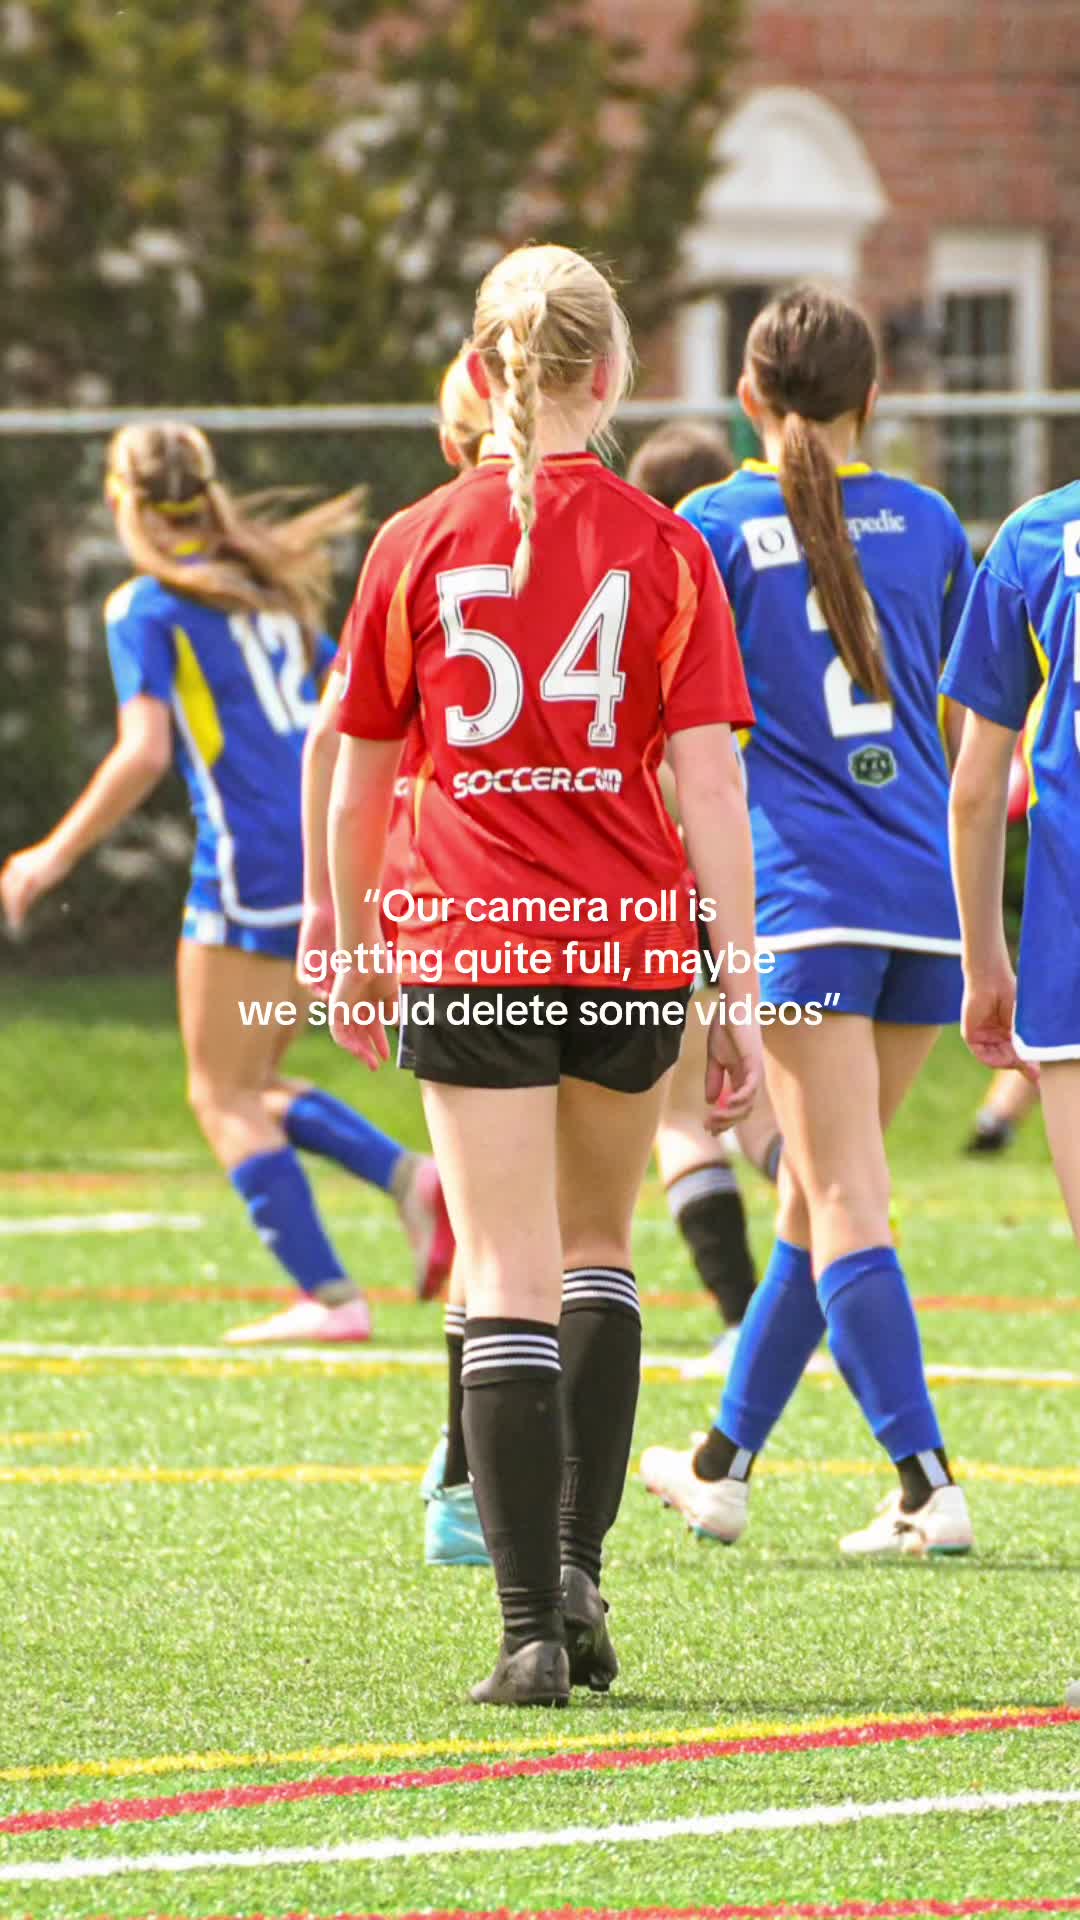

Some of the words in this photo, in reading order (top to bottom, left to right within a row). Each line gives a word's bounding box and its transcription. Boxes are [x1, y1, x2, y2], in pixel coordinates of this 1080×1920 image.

[846, 508, 906, 541] pedic
[228, 611, 320, 736] 12
[436, 564, 630, 747] 54
